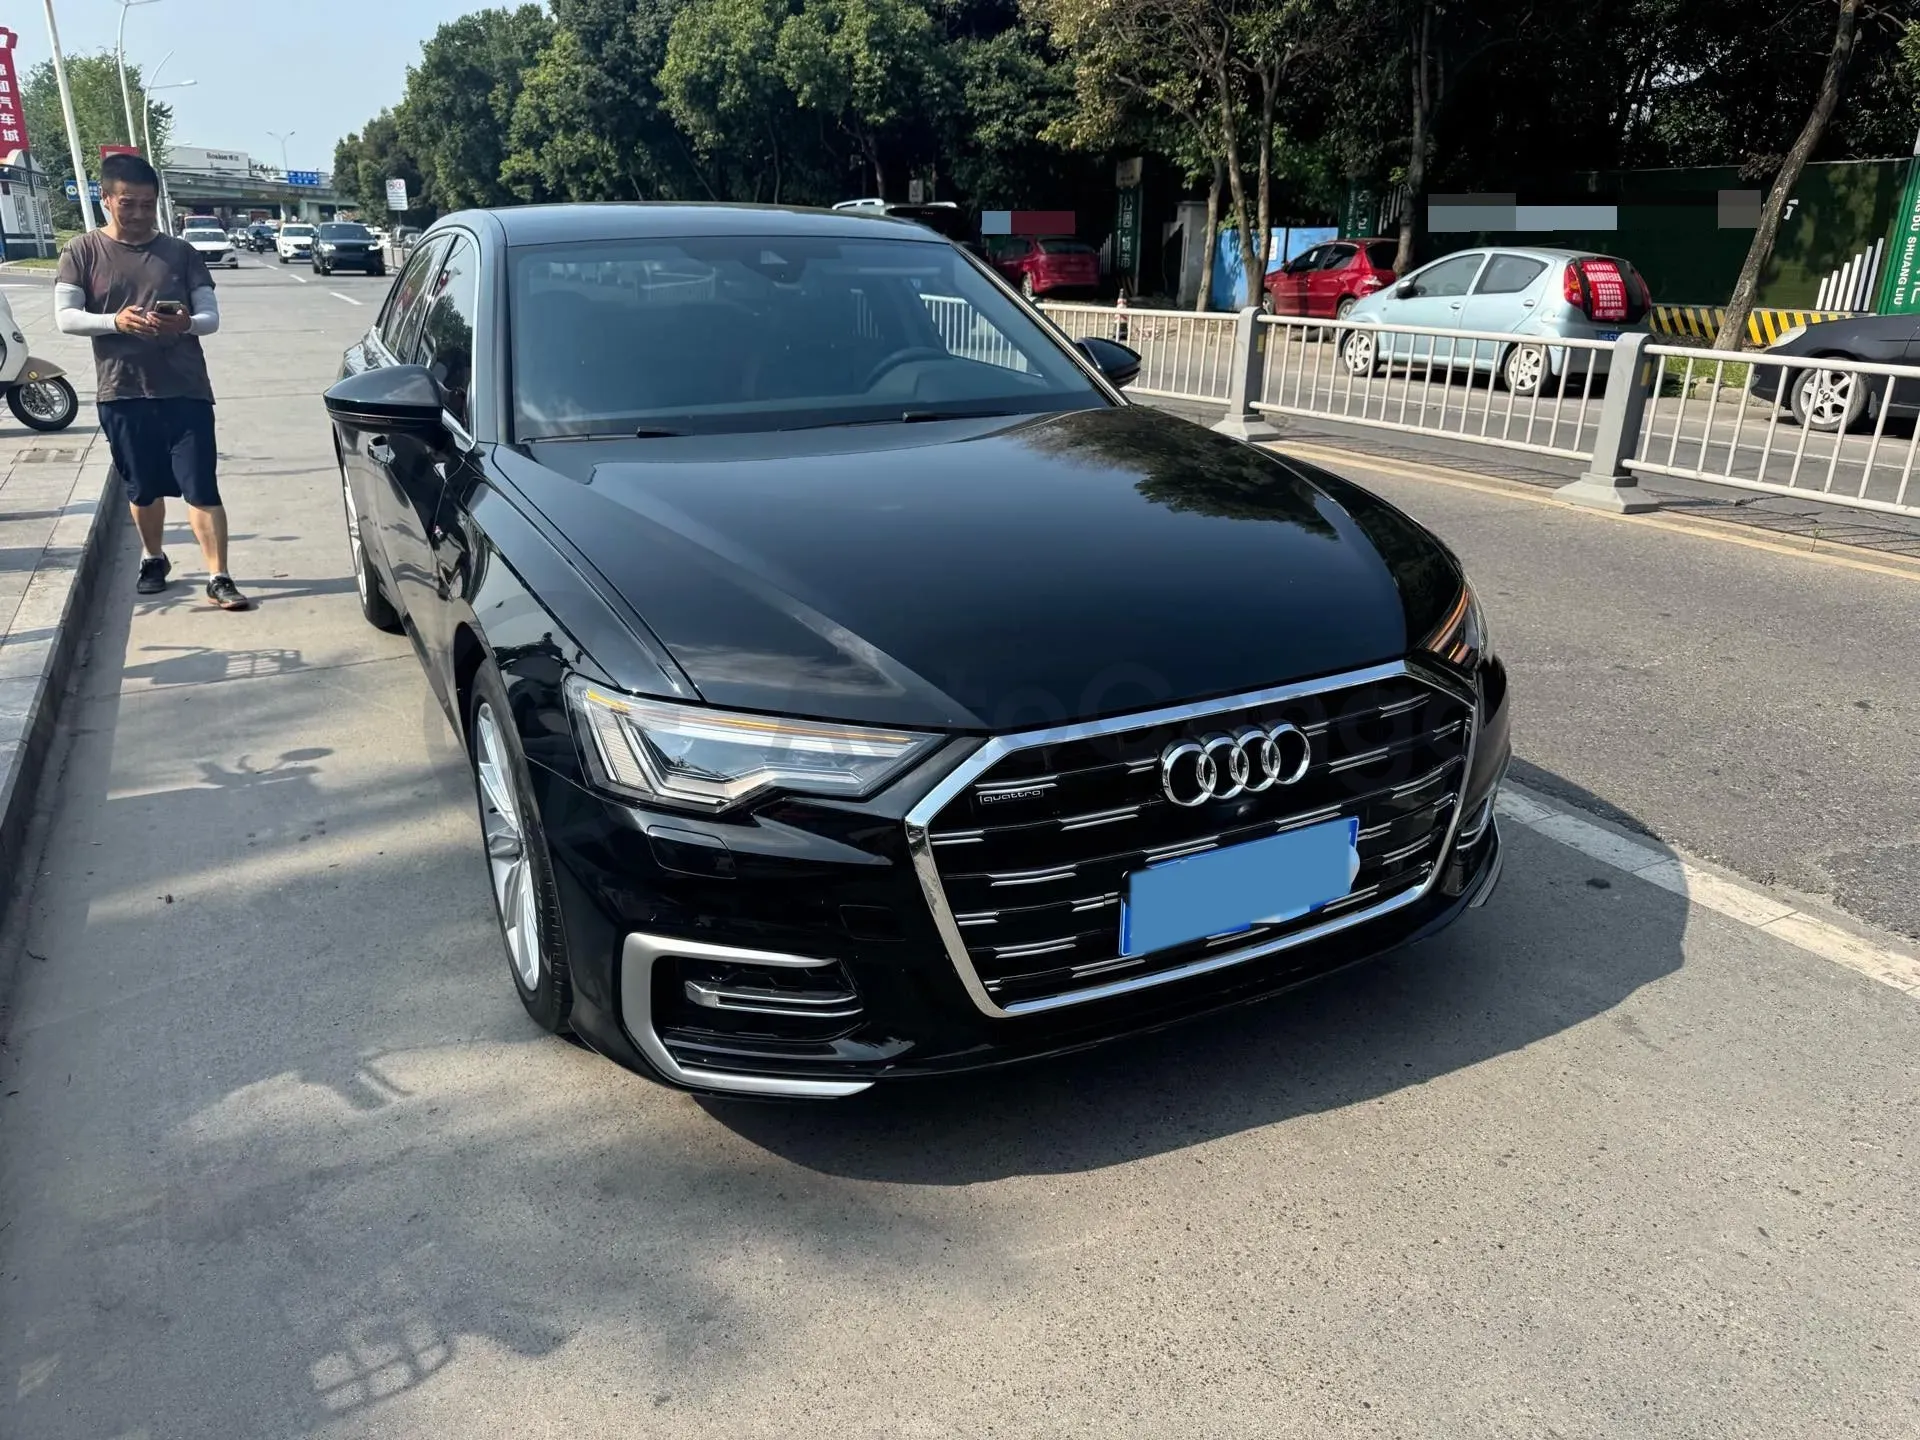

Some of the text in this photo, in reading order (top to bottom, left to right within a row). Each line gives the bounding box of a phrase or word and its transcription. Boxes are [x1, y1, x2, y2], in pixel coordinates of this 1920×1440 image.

[1897, 236, 1917, 285] SHUANG
[1894, 287, 1906, 305] LIU
[983, 789, 1041, 803] quattro
